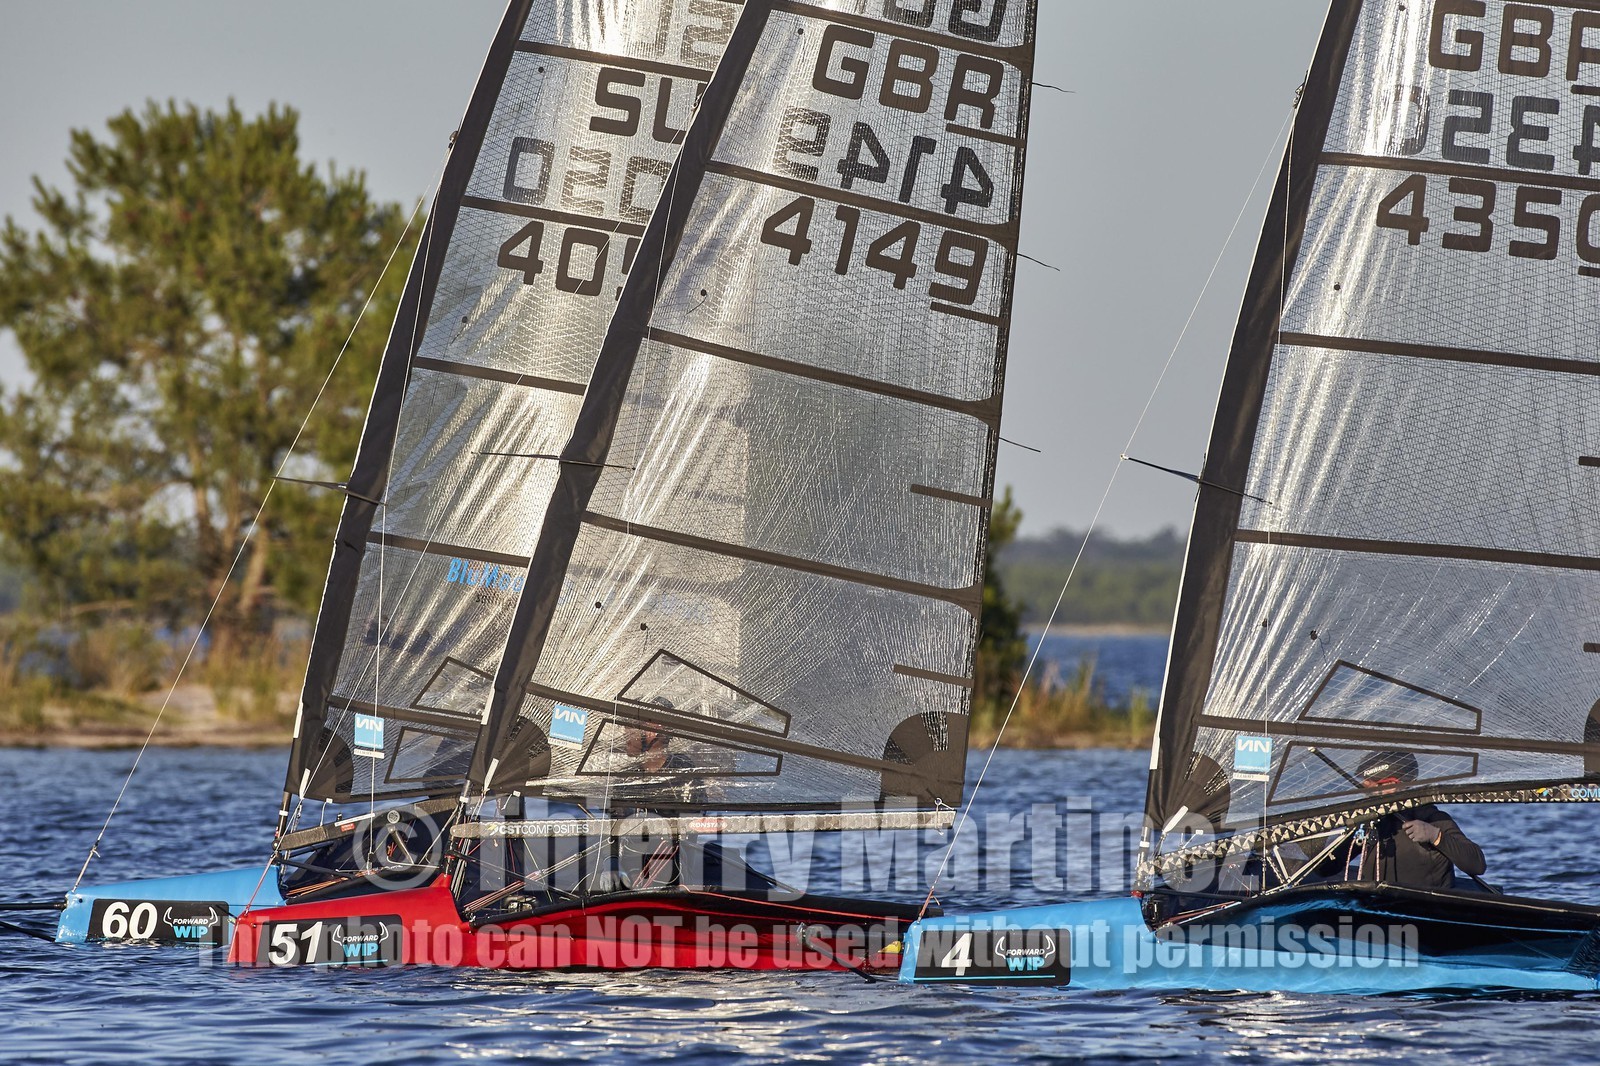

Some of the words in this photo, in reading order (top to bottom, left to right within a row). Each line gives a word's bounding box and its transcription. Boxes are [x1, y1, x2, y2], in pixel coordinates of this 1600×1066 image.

[812, 24, 1004, 129] GBR
[760, 195, 989, 306] 4149
[102, 901, 158, 940] 60
[173, 925, 209, 939] WIP
[268, 921, 323, 967] 51
[342, 935, 379, 943] FORWARD
[343, 943, 379, 957] WIP
[1006, 948, 1046, 956] FORWARD
[941, 932, 973, 976] 4
[1006, 956, 1046, 972] WIP
